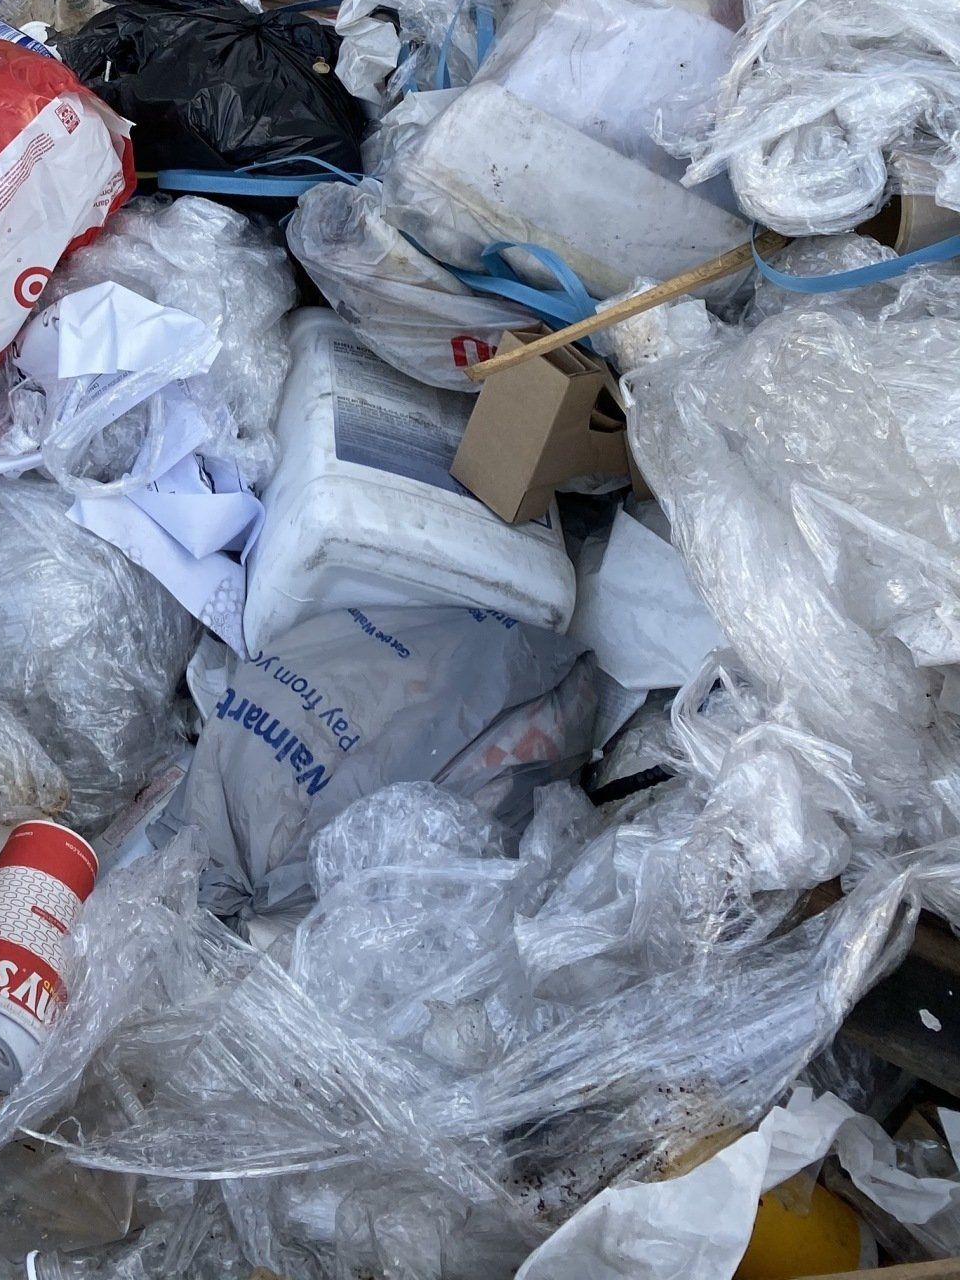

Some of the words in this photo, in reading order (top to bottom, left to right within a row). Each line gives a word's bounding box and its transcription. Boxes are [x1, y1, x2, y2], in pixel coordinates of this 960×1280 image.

[347, 607, 377, 636] Walm
[273, 666, 323, 710] from
[319, 708, 360, 751] Pay
